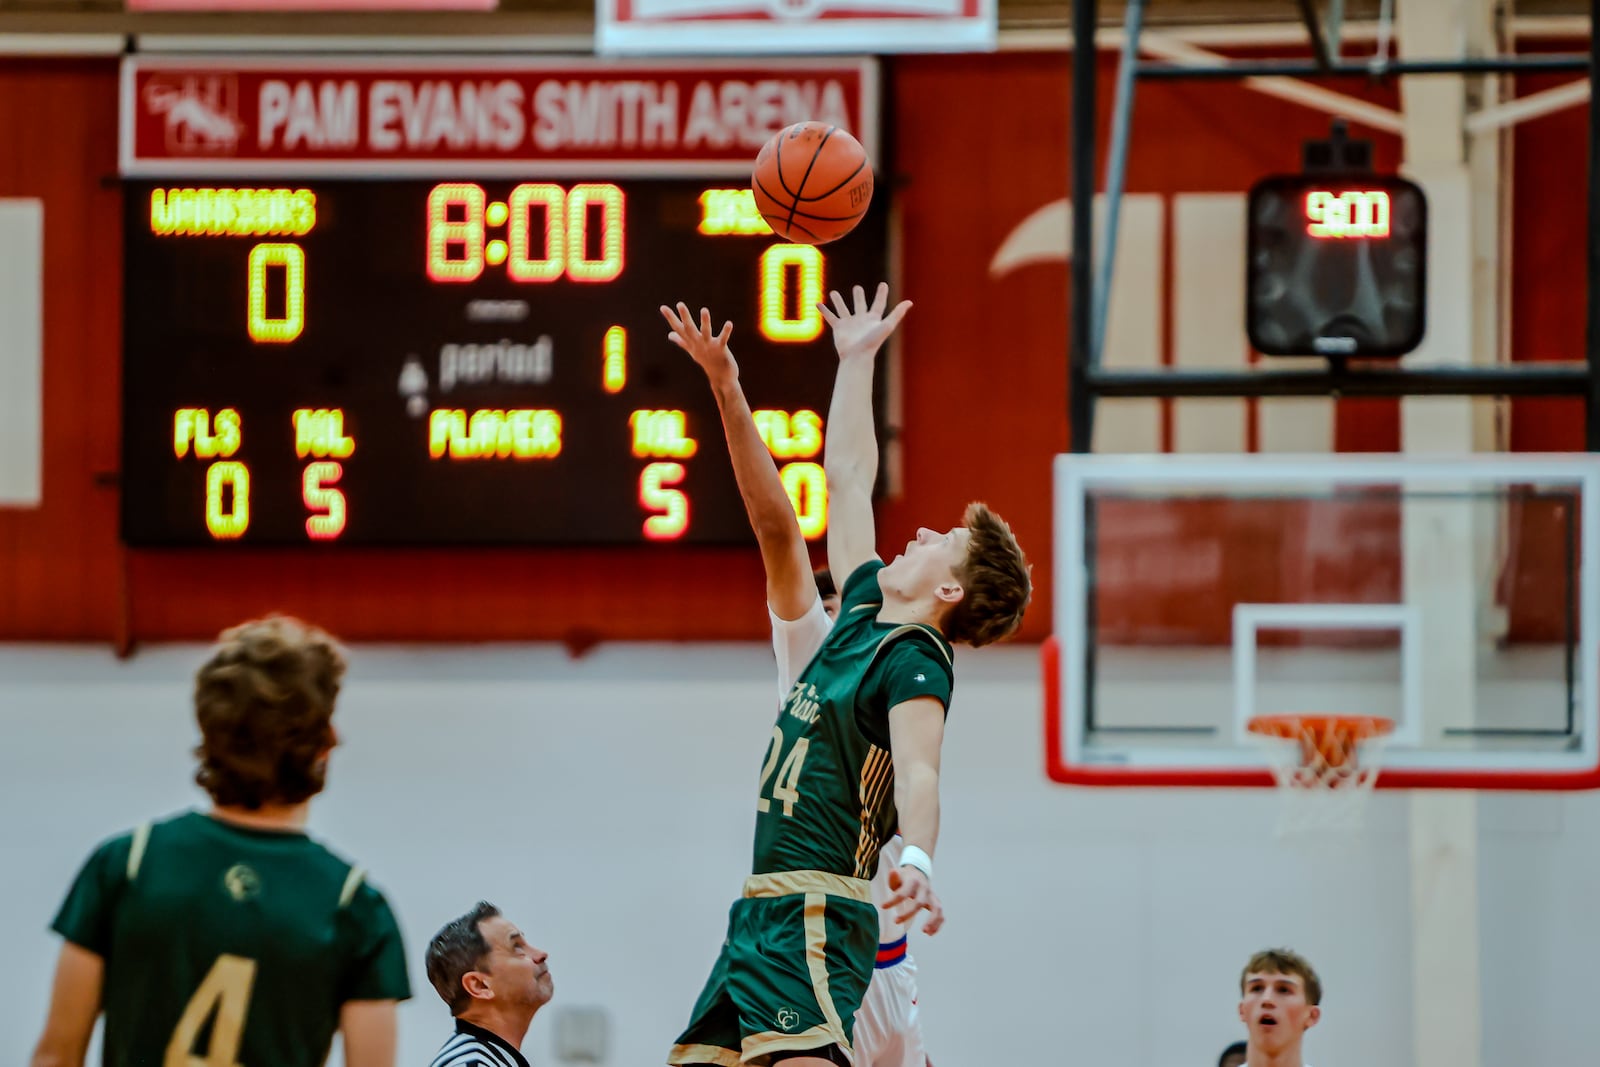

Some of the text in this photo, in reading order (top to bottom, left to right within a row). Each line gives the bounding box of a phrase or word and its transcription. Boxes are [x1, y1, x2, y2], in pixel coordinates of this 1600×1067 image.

[258, 79, 850, 150] PAM EVANS SMITH ARENA
[427, 183, 625, 283] 8:00
[1305, 190, 1391, 239] 9:00
[247, 242, 305, 342] 0
[759, 243, 824, 342] 0
[440, 335, 553, 392] period
[602, 325, 627, 394] 1
[174, 408, 241, 458] FLS
[429, 408, 562, 459] PLAYER
[206, 461, 250, 539] 0
[302, 461, 347, 540] 5
[639, 461, 689, 540] 5
[779, 461, 828, 540] 0
[757, 725, 810, 817] 24
[163, 953, 258, 1067] 4
